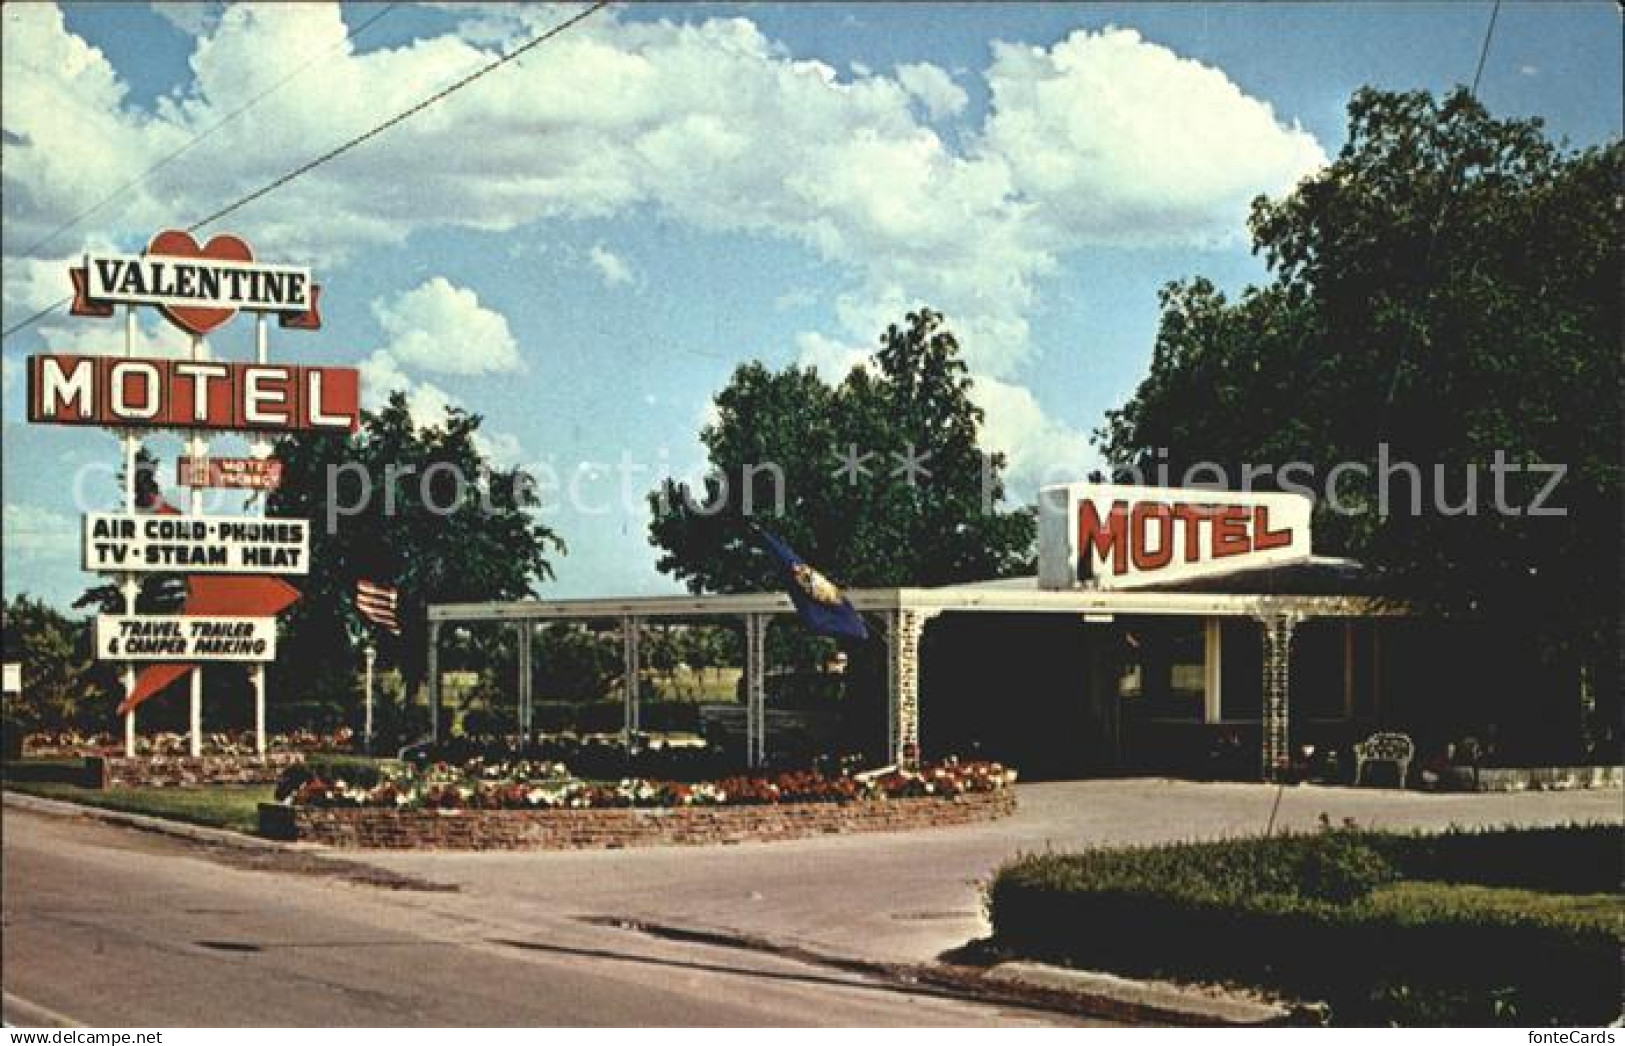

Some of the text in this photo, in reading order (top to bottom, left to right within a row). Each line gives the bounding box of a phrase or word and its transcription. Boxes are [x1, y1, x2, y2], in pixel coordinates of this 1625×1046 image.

[95, 259, 306, 305] VALENTINE
[41, 359, 353, 427] MOTEL
[93, 519, 136, 539] AIR
[219, 522, 303, 543] PHONES
[1077, 498, 1293, 581] MOTEL
[95, 543, 301, 567] TV STEAM HEAT
[119, 621, 255, 637] TRAVEL TRAILER
[108, 637, 267, 655] & CAMPER PARKING
